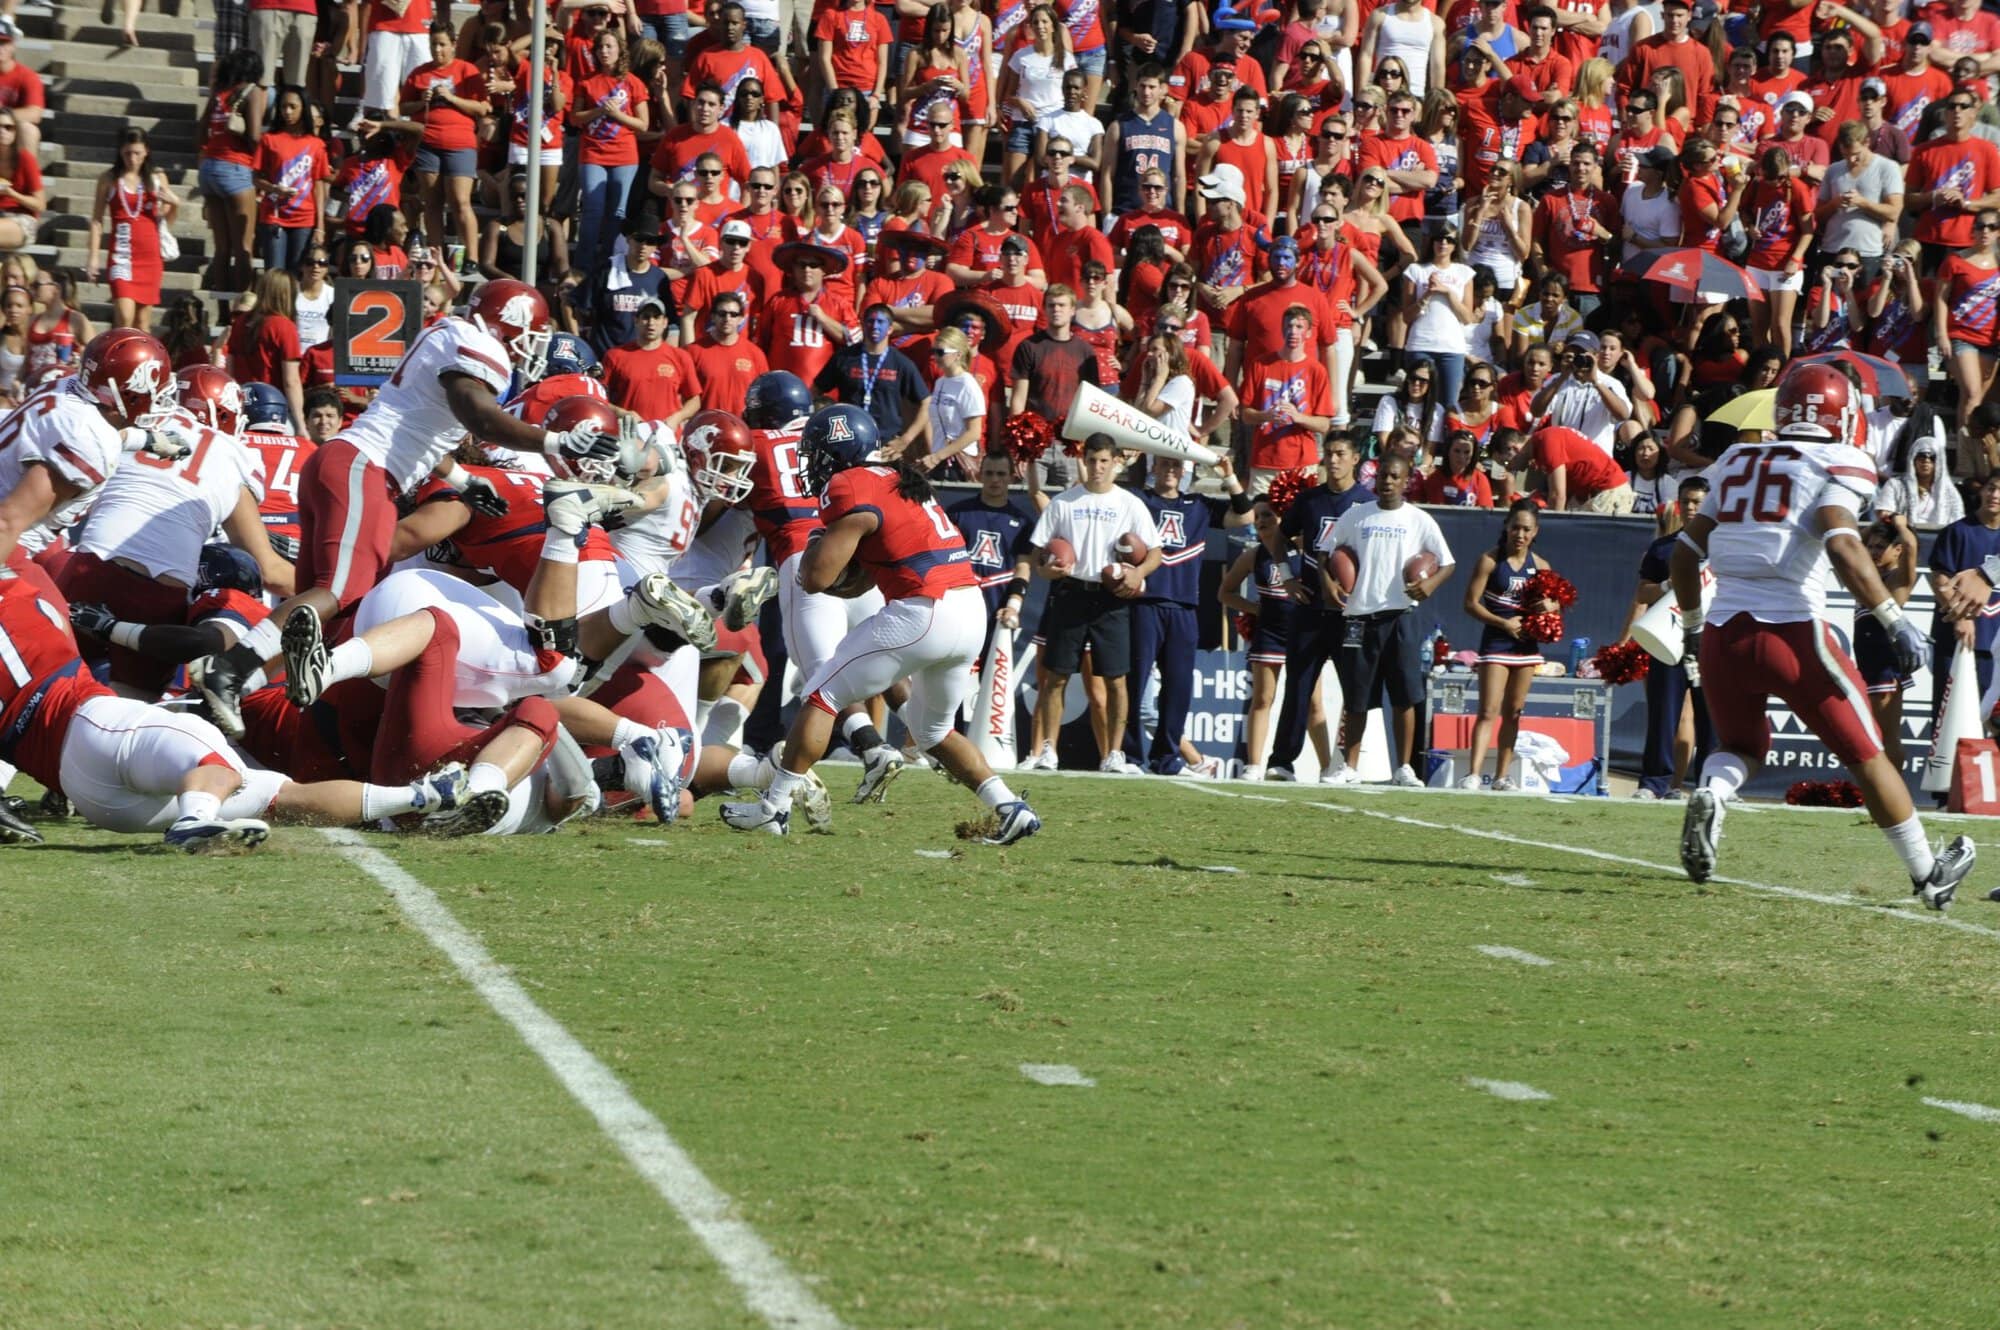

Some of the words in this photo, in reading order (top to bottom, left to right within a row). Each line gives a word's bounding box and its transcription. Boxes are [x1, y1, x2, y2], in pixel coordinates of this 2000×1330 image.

[1135, 153, 1160, 174] 34
[349, 290, 406, 357] 2
[789, 314, 824, 348] 10
[349, 356, 401, 367] DIAL-A-DOW
[827, 415, 855, 444] A
[1791, 403, 1818, 423] 26
[1716, 446, 1802, 523] 26
[1158, 510, 1187, 548] A
[968, 530, 1003, 569] A
[988, 646, 1009, 736] ARIZONA
[1765, 750, 1842, 769] RPRIS
